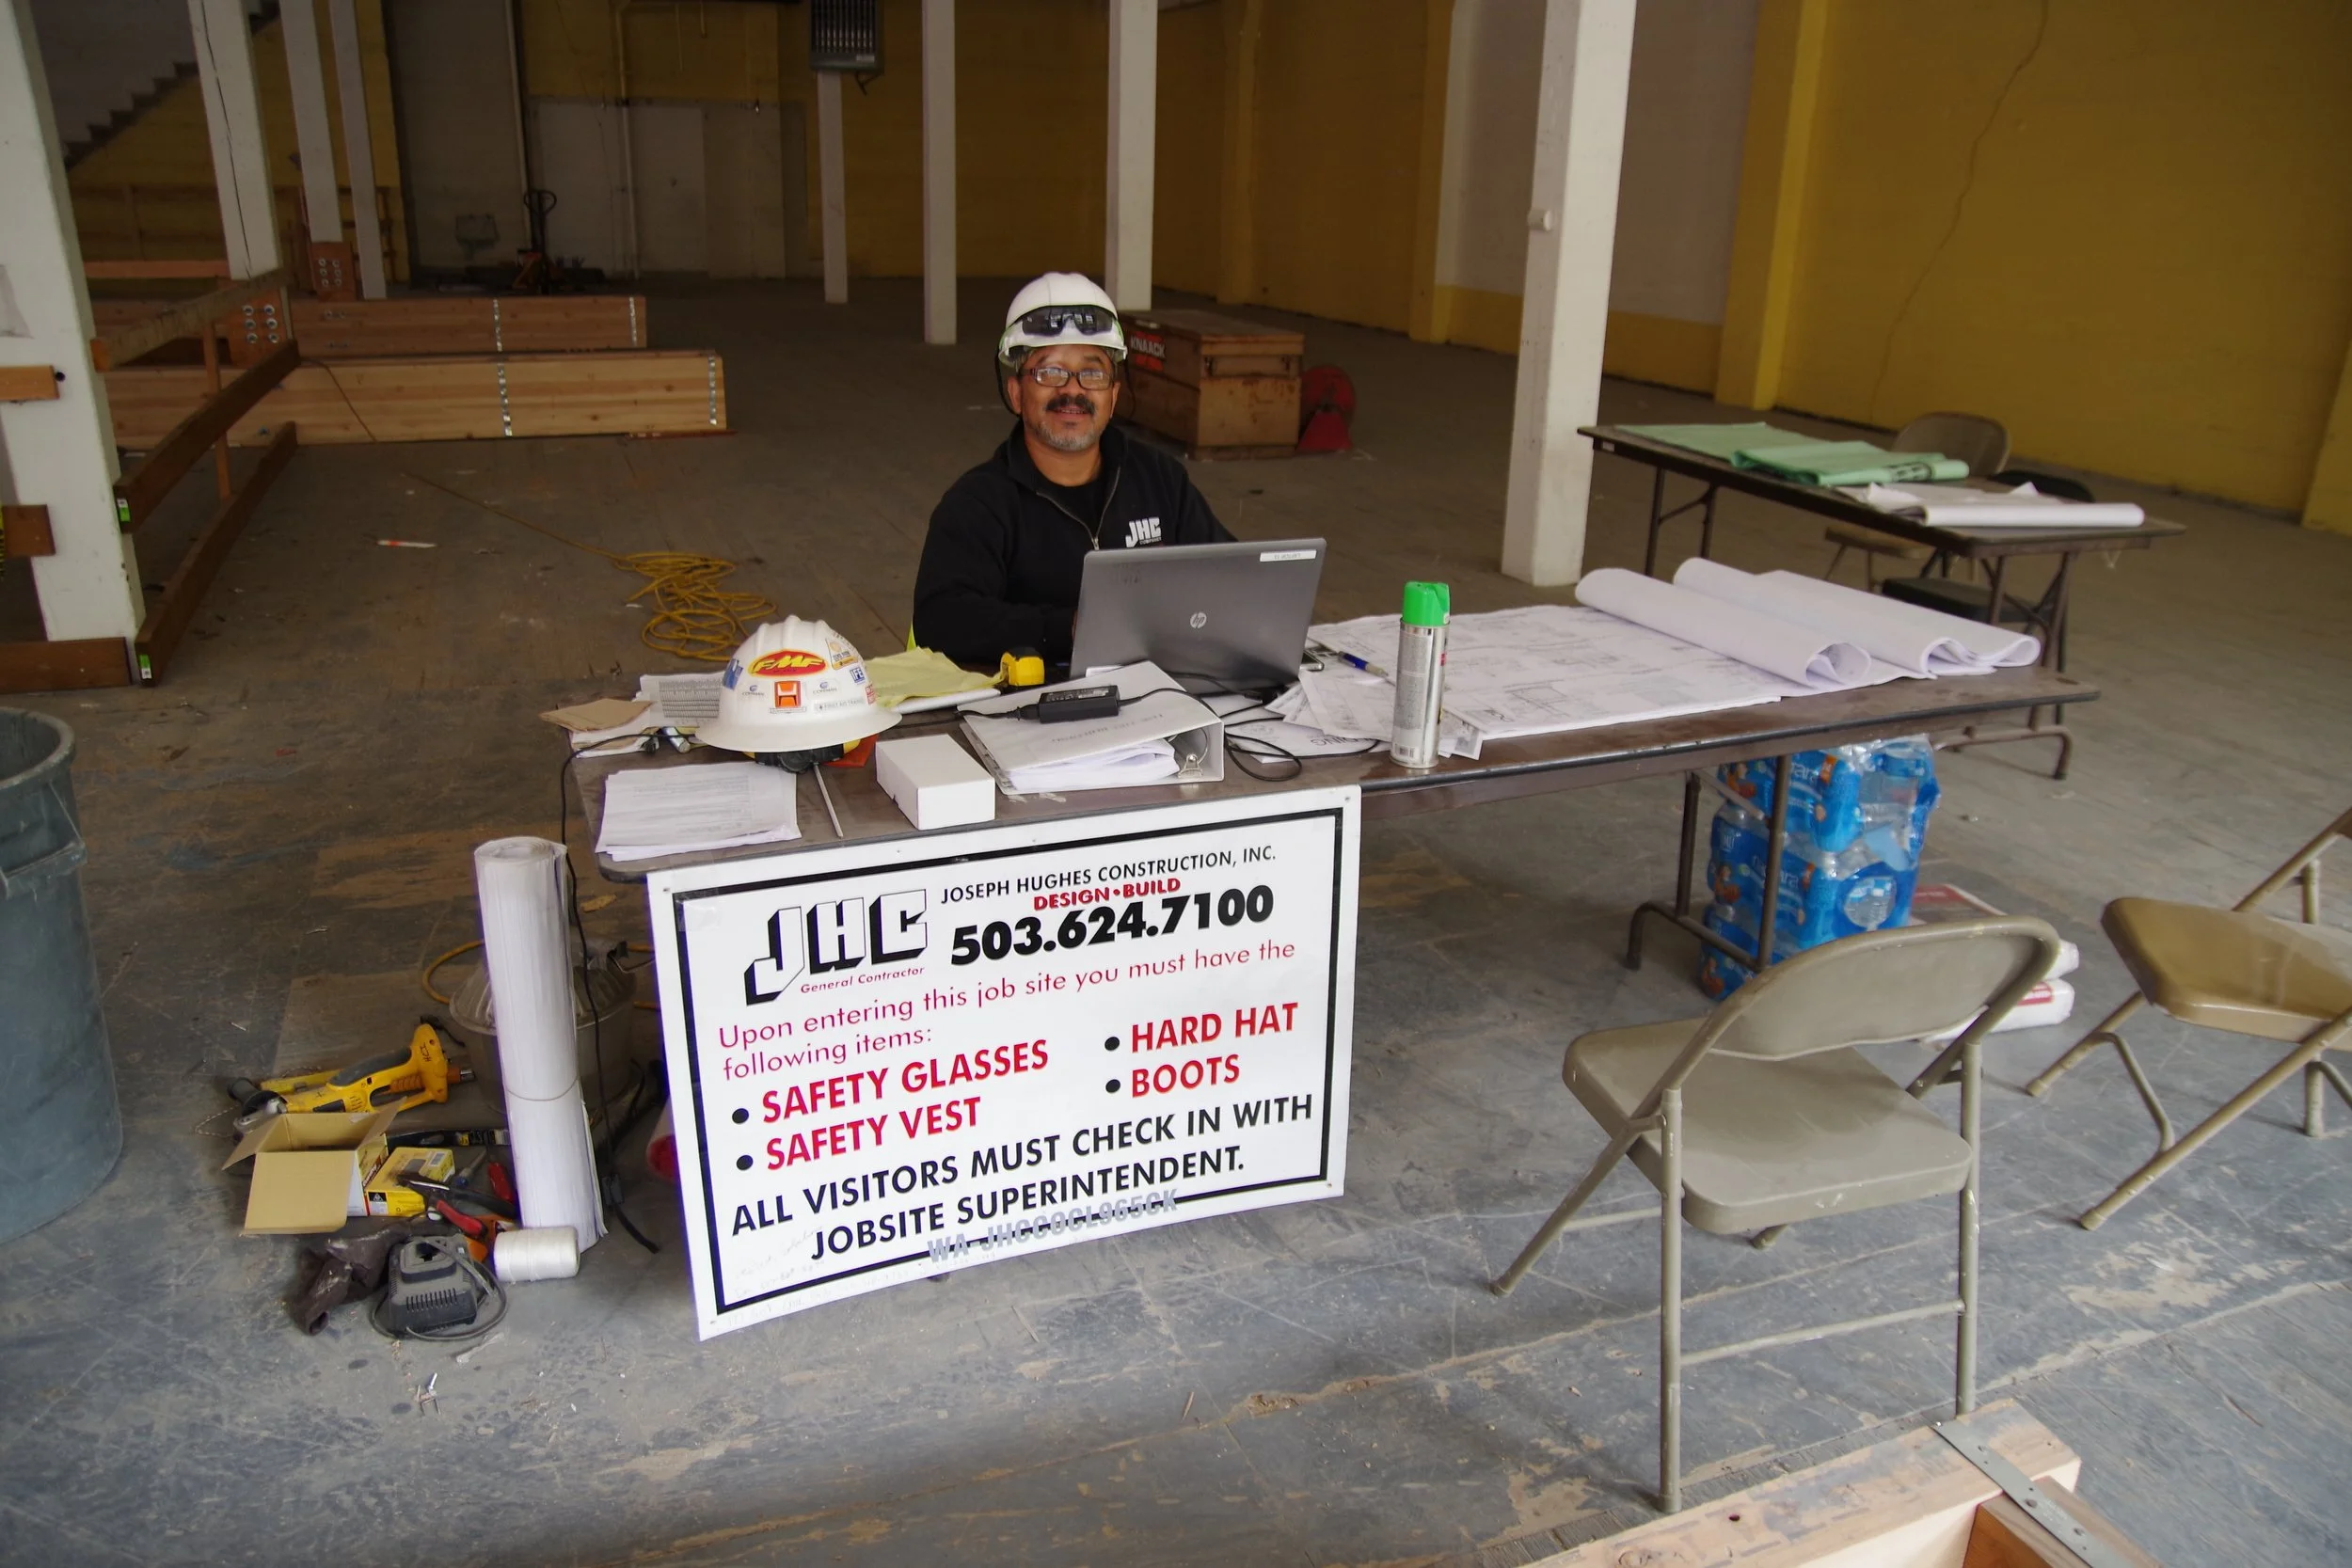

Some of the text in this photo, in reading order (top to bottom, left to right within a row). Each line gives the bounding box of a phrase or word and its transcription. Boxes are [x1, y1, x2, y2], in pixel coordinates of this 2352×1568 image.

[1131, 335, 1166, 357] KNAACK
[1125, 517, 1161, 547] JHC
[753, 655, 823, 672] FMF
[941, 846, 1276, 904] JOSEPH HUGHES CONSTRUCTION, INC.
[743, 889, 928, 1006] JHC
[951, 885, 1274, 966] 503.624.7100
[719, 939, 1295, 1051] Upon entering this job site you must have the
[801, 966, 925, 993] General Contractor
[723, 1028, 931, 1081] following items:
[1132, 1002, 1298, 1053] HARD HAT
[762, 1038, 1049, 1124] SAFETY GLASSES
[1132, 1053, 1240, 1098] BOOTS
[766, 1096, 981, 1171] SAFETY VEST
[732, 1094, 1312, 1237] ALL VISITORS MUST CHECK IN WITH
[811, 1145, 1245, 1260] JOBSITE SUPERINTENDENT.
